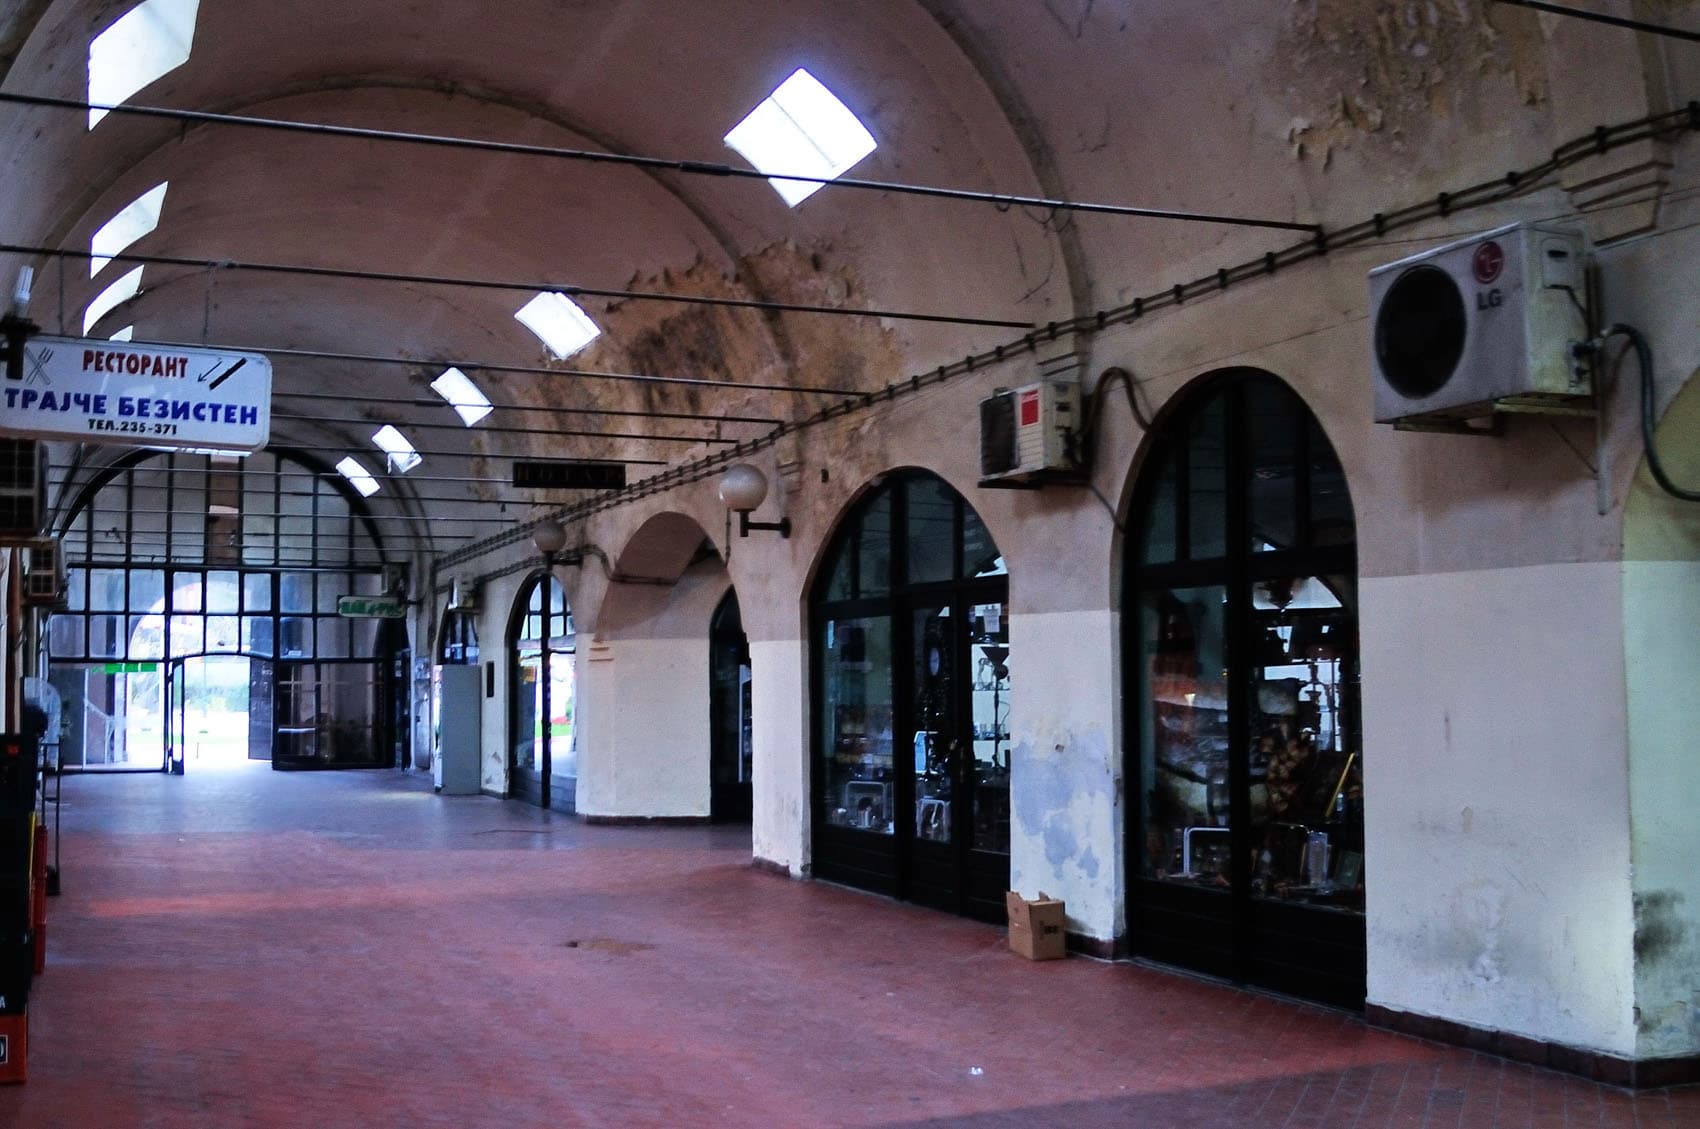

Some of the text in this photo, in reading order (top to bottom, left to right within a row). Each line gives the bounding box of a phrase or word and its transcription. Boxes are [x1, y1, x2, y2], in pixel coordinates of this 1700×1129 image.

[1476, 289, 1502, 310] LG
[83, 350, 189, 378] РЕСТОРАНТ
[5, 388, 258, 425] ТРАЈЧЕ БЕЗИСТЕН
